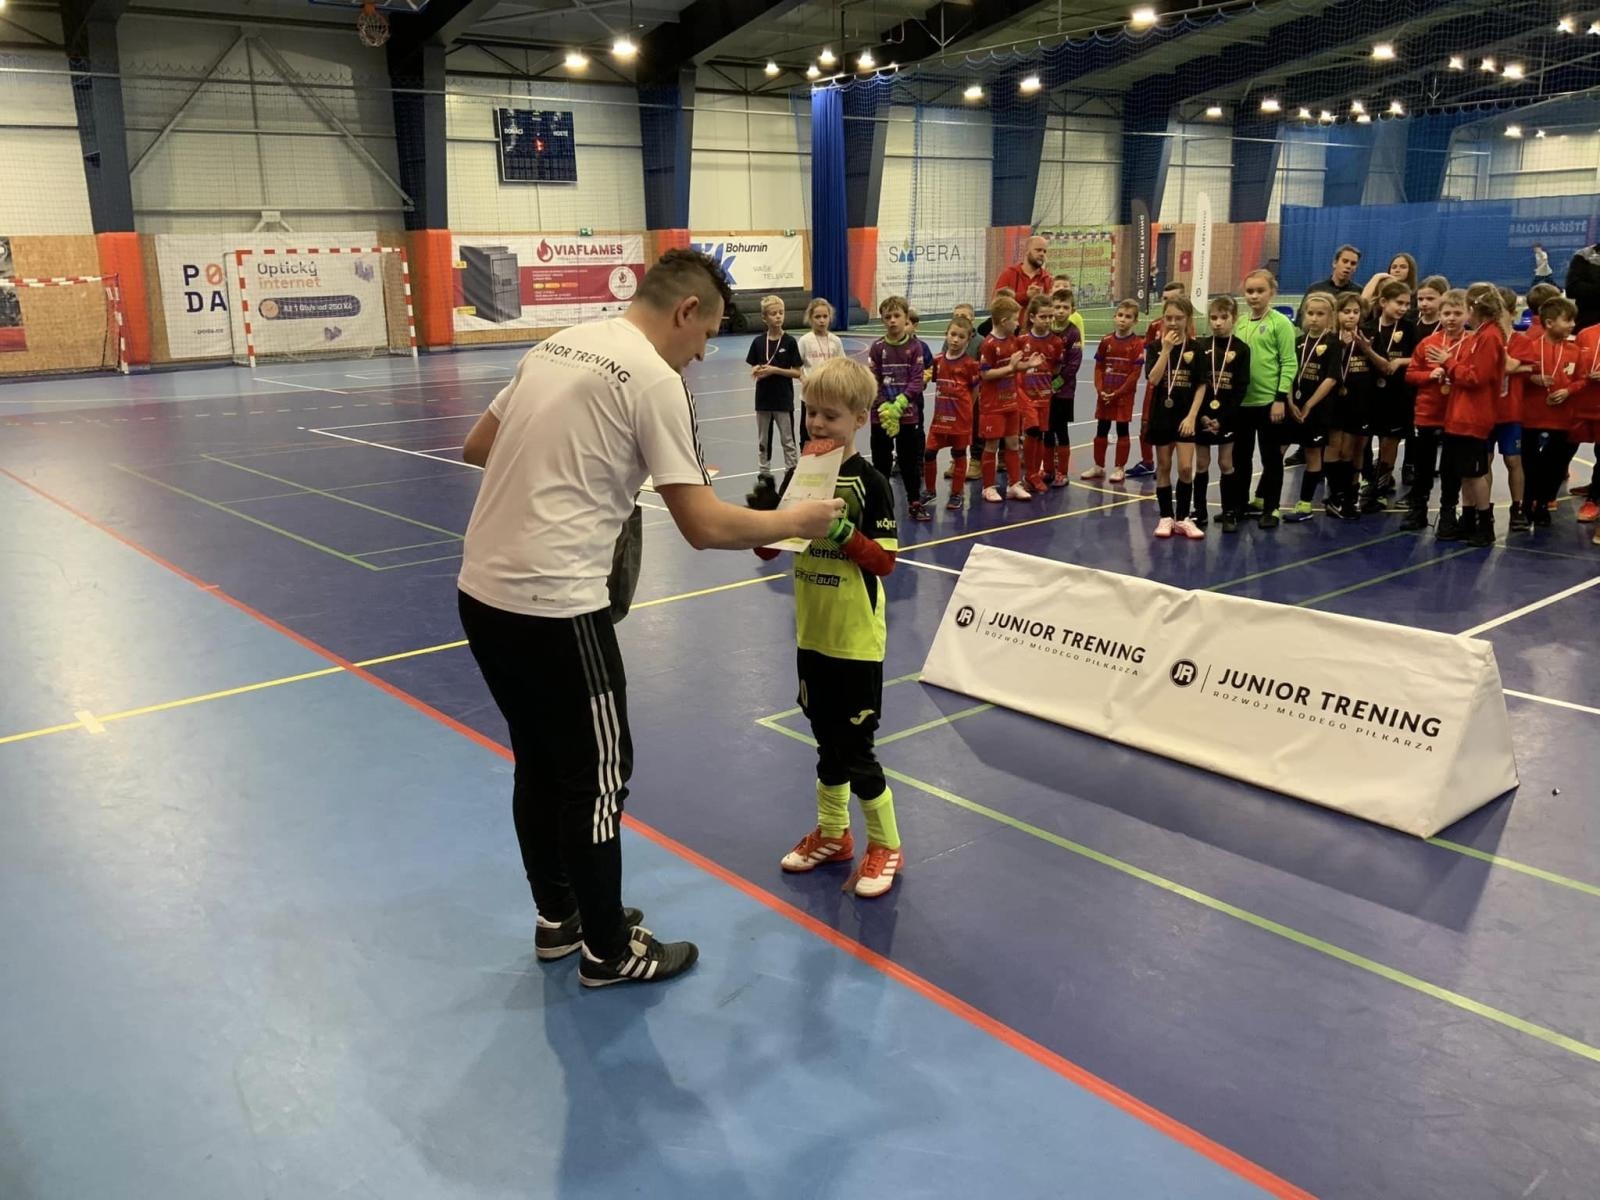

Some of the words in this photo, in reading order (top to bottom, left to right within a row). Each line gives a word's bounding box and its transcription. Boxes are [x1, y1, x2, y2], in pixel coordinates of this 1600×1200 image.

[554, 244, 623, 256] VIAFLAMES
[726, 242, 768, 253] Bohumín
[257, 261, 317, 277] Optický
[259, 277, 321, 289] internet
[540, 342, 572, 358] NIOR
[572, 350, 631, 384] TRENING
[984, 630, 1025, 645] ROZWÓJ
[1029, 642, 1080, 661] MŁODEGO
[1085, 657, 1139, 676] PIŁKARZA
[989, 612, 1055, 641] JUNIOR
[1060, 628, 1146, 663] TRENING
[1213, 690, 1269, 711] ROZWÓJ
[1276, 706, 1347, 731] MŁODEGO
[1355, 727, 1434, 752] PIŁKARZA
[1218, 668, 1311, 706] JUNIOR
[1320, 691, 1442, 738] TRENING
